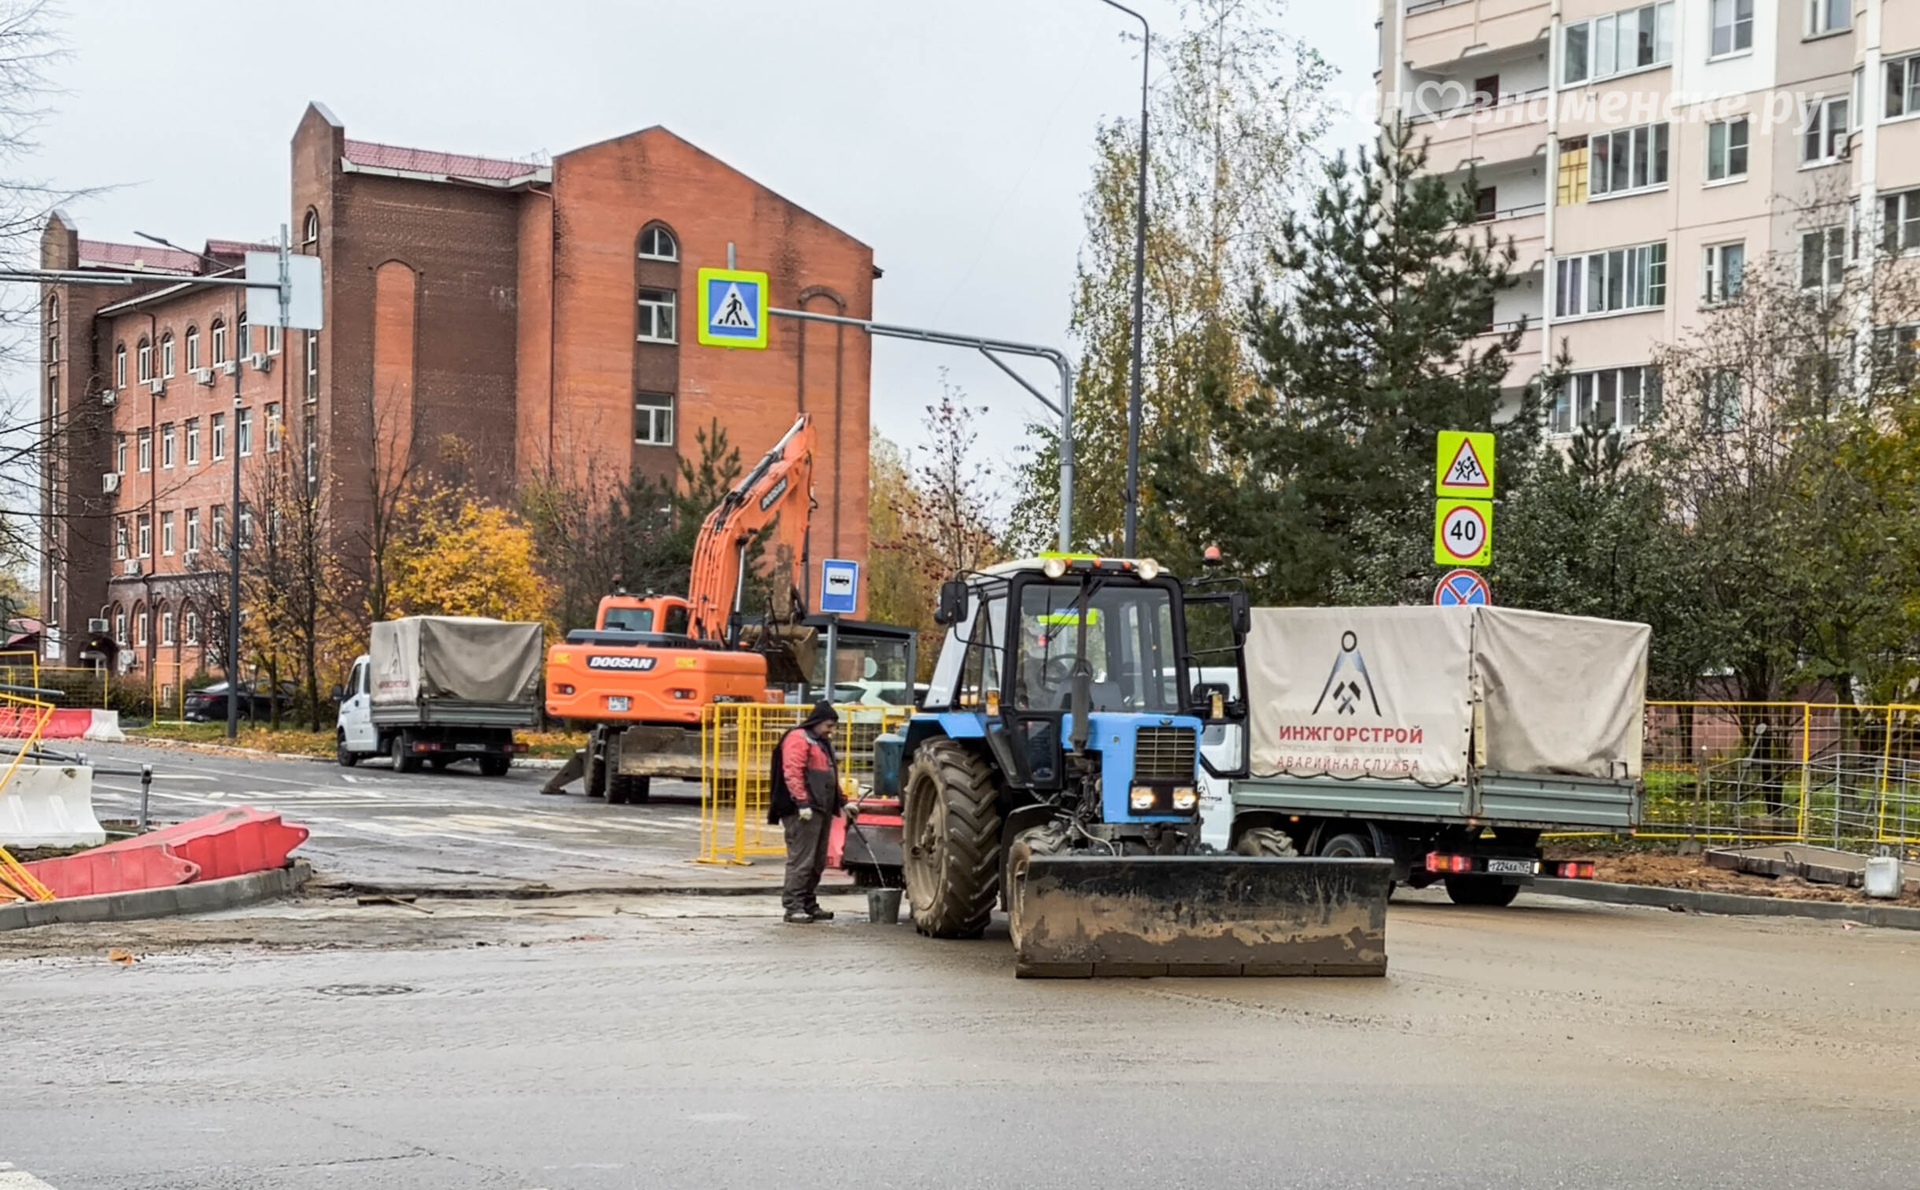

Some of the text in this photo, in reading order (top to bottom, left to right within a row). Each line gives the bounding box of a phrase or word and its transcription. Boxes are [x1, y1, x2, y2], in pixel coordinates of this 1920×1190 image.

[1450, 519, 1477, 541] 40
[589, 656, 653, 669] DOOSAN
[1279, 725, 1424, 744] ИНЖГОРСТРОЙ
[1277, 756, 1420, 772] АВАРИЙНАЯ СЛУЖБА
